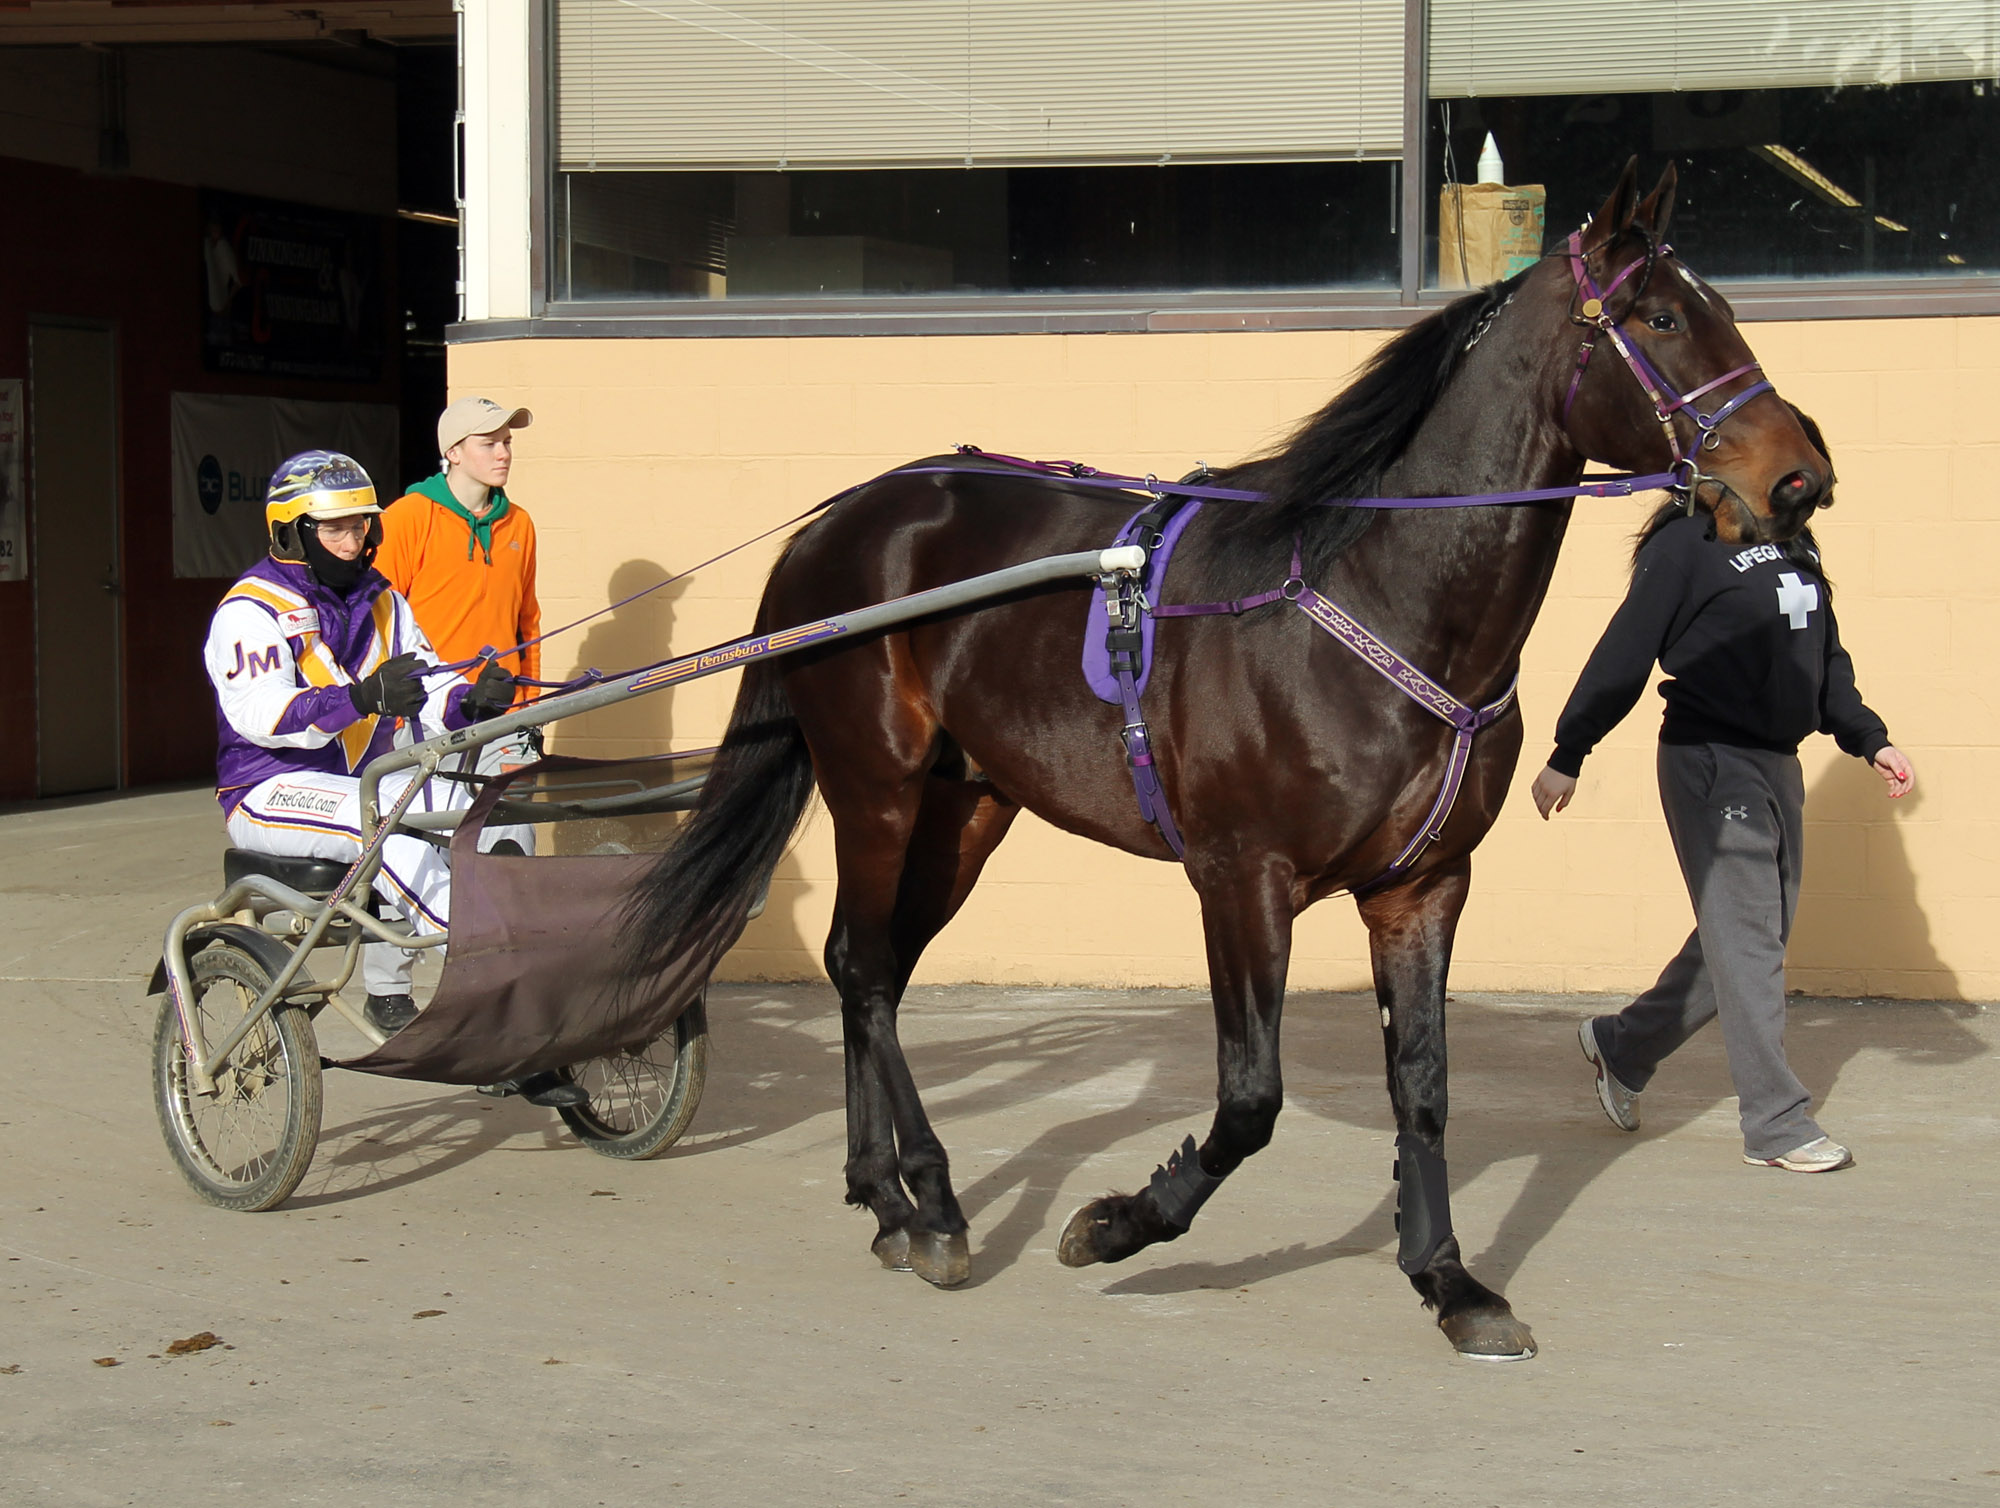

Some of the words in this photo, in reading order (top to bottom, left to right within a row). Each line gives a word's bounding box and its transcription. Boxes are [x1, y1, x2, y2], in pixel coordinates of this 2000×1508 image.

[228, 471, 273, 501] BLU
[226, 640, 282, 681] JM
[700, 644, 766, 668] Pennsbury
[1311, 599, 1395, 669] HURRIKANE
[1397, 668, 1457, 715] RACING
